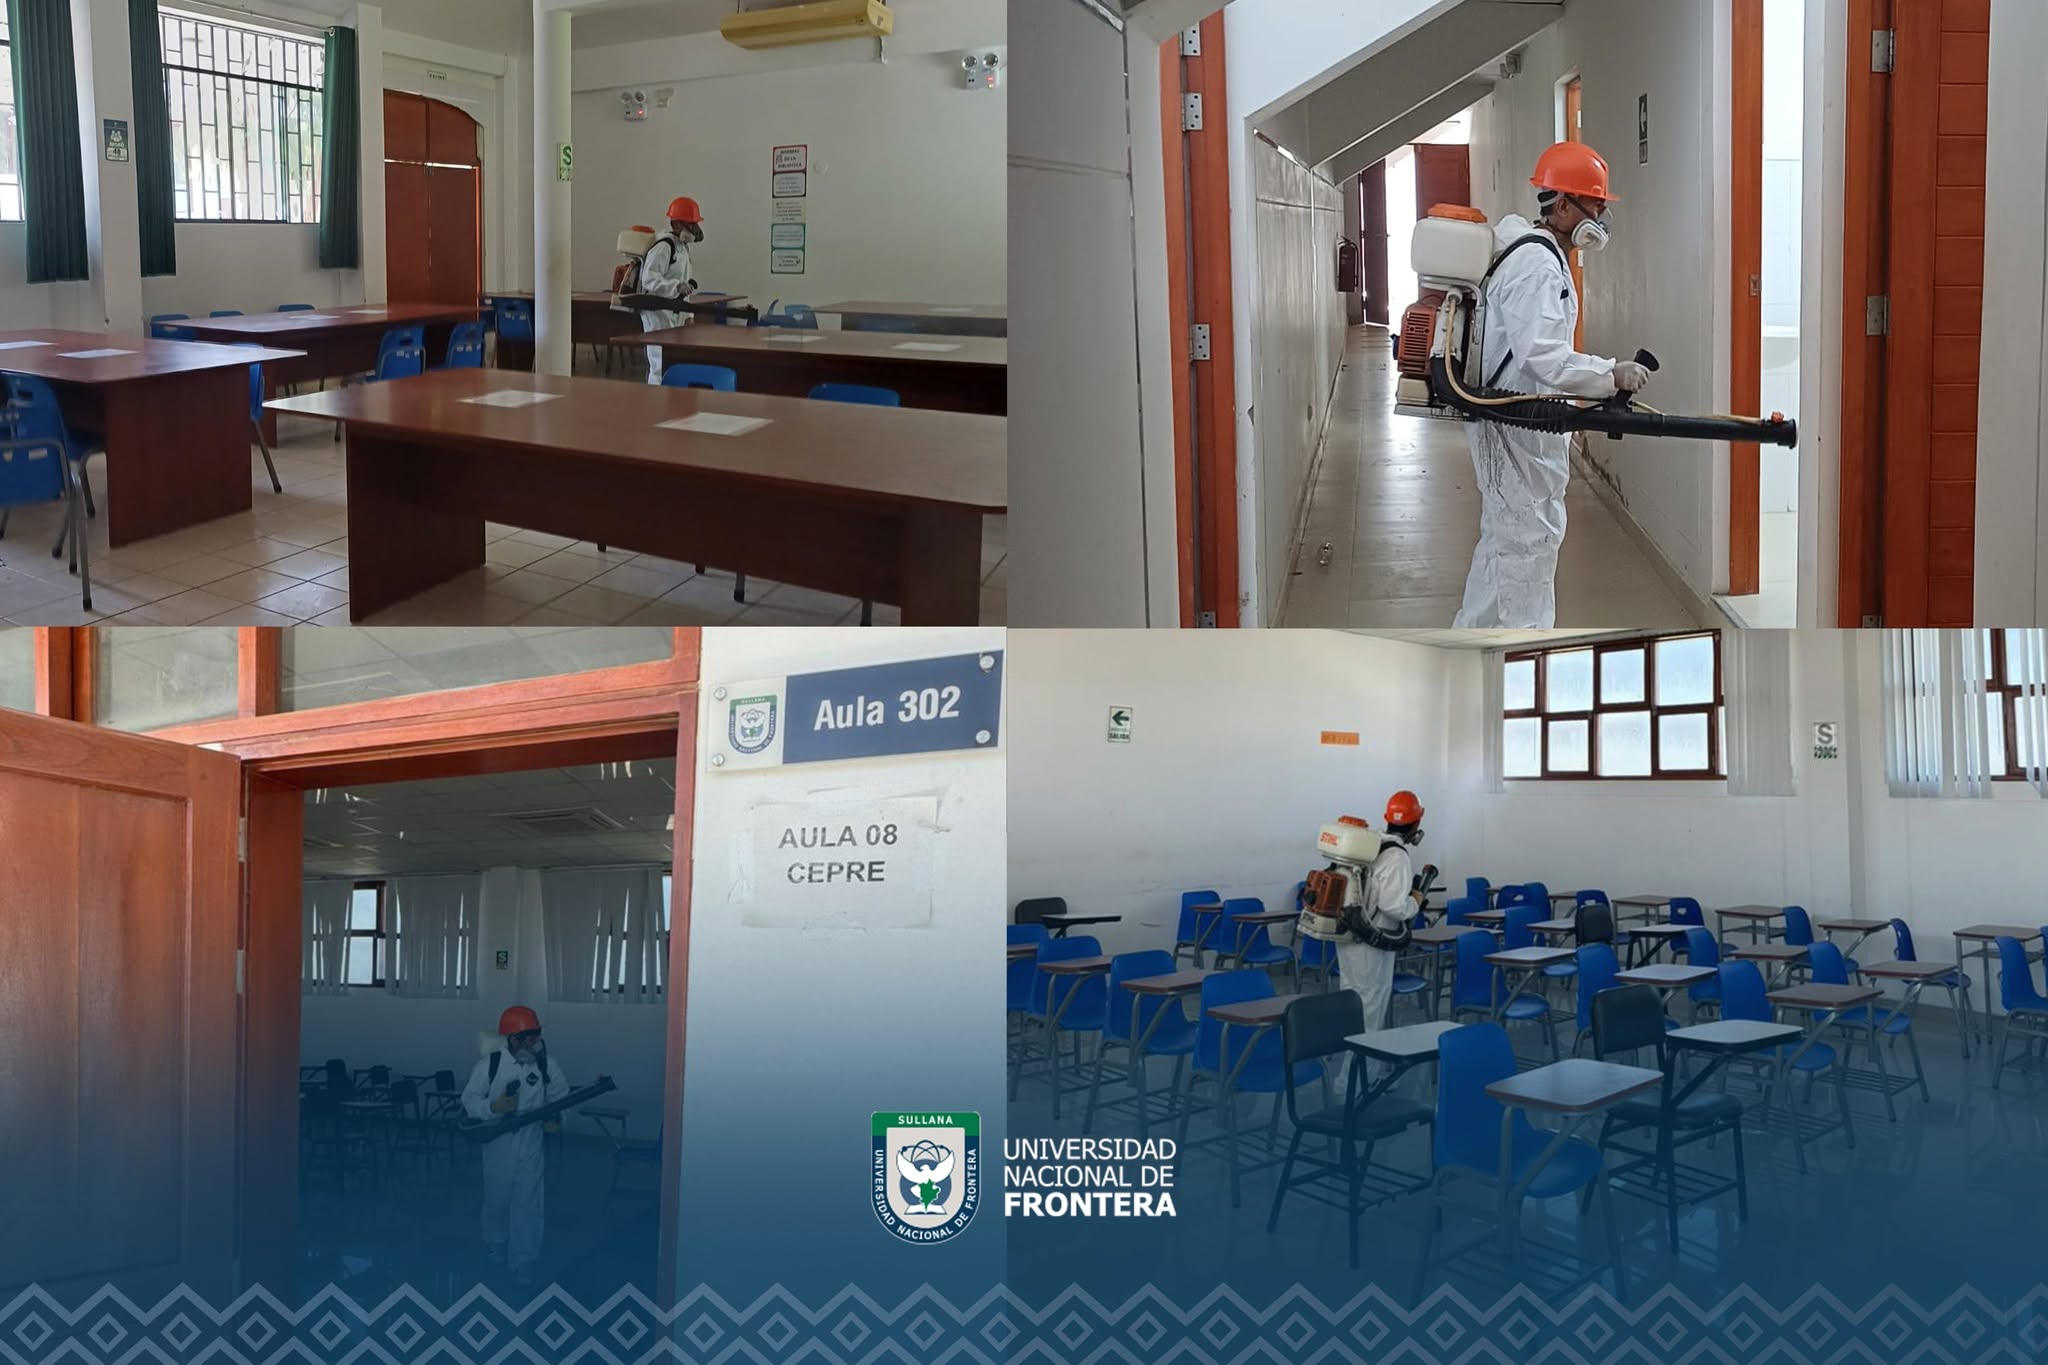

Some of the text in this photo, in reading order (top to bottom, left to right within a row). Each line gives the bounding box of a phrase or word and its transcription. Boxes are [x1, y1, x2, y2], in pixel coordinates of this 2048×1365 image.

[562, 145, 571, 166] S
[814, 686, 961, 731] Aula 302
[1818, 724, 1833, 744] S
[778, 824, 898, 849] AULA 08
[787, 861, 885, 884] CEPRE
